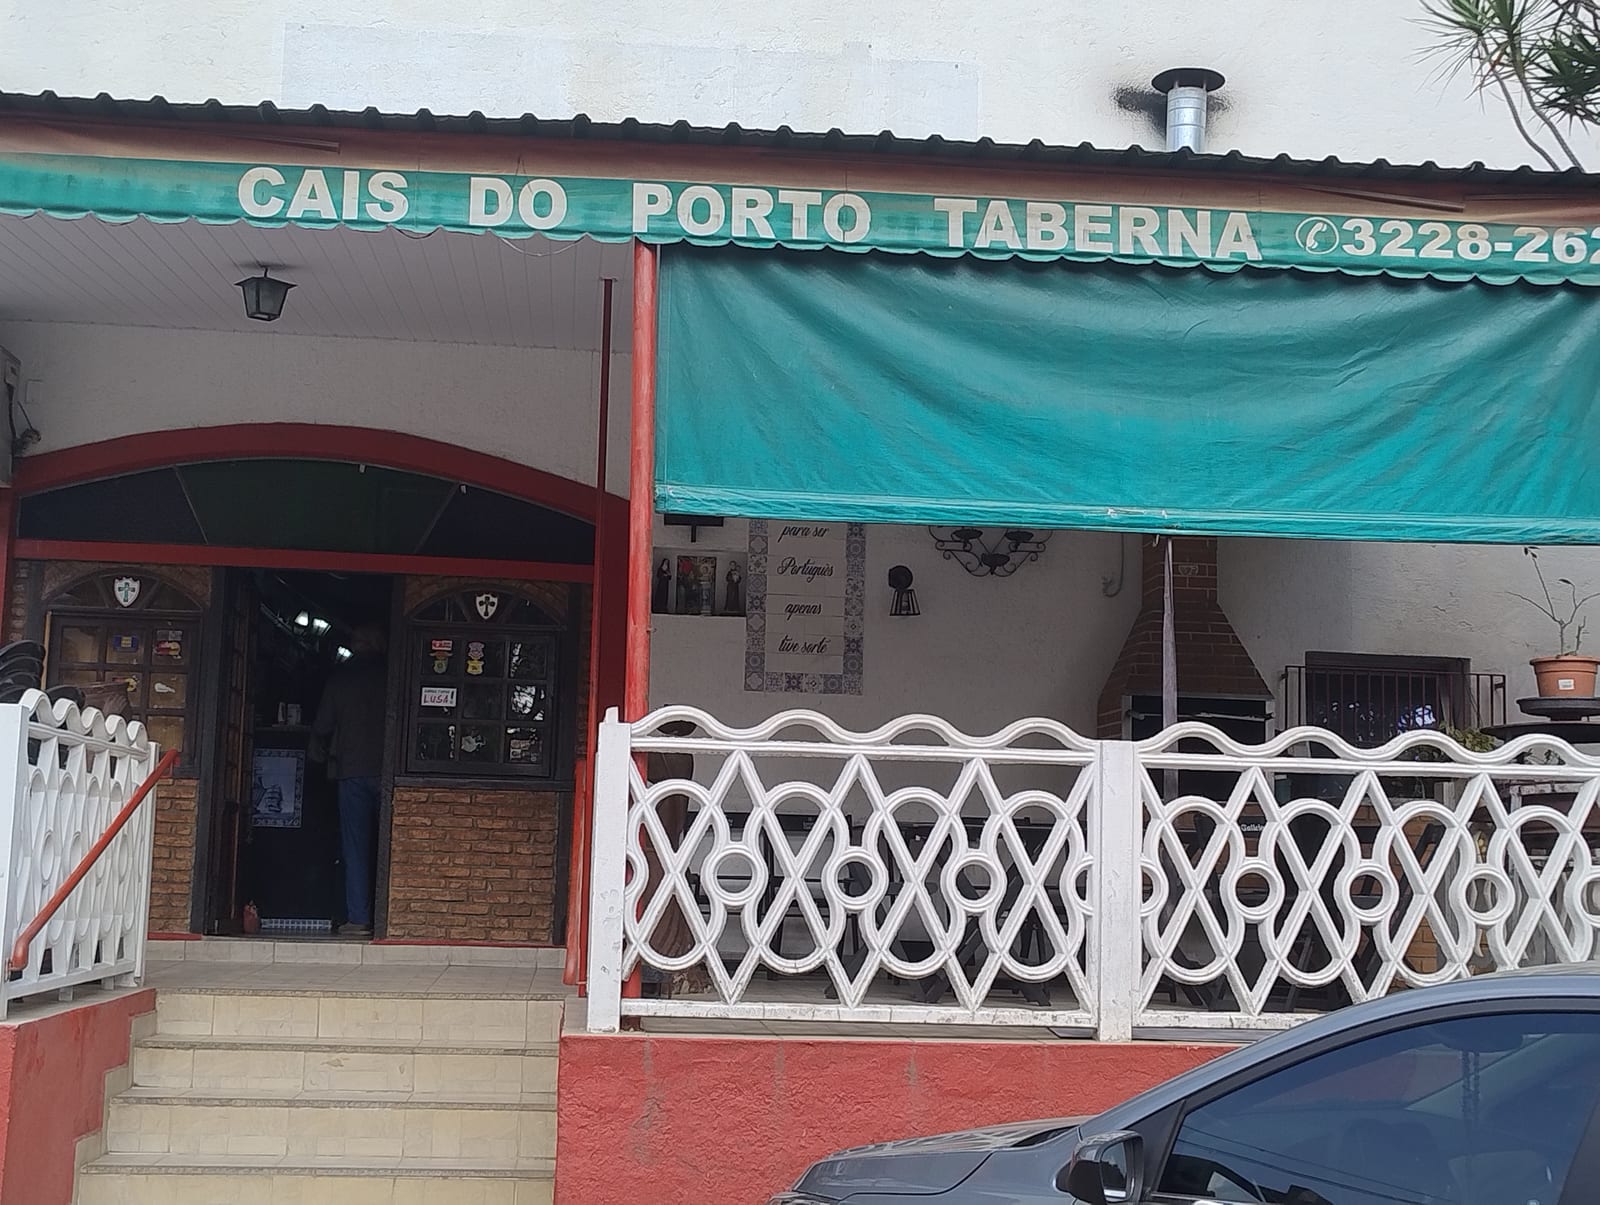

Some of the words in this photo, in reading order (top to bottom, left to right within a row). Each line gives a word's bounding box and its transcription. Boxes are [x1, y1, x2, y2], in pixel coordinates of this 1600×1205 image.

[238, 167, 409, 222] CAIS
[469, 177, 567, 229] DO
[632, 182, 872, 243] PORTO
[934, 198, 1263, 261] TABERNA
[777, 526, 811, 543] para
[785, 603, 822, 621] apenas
